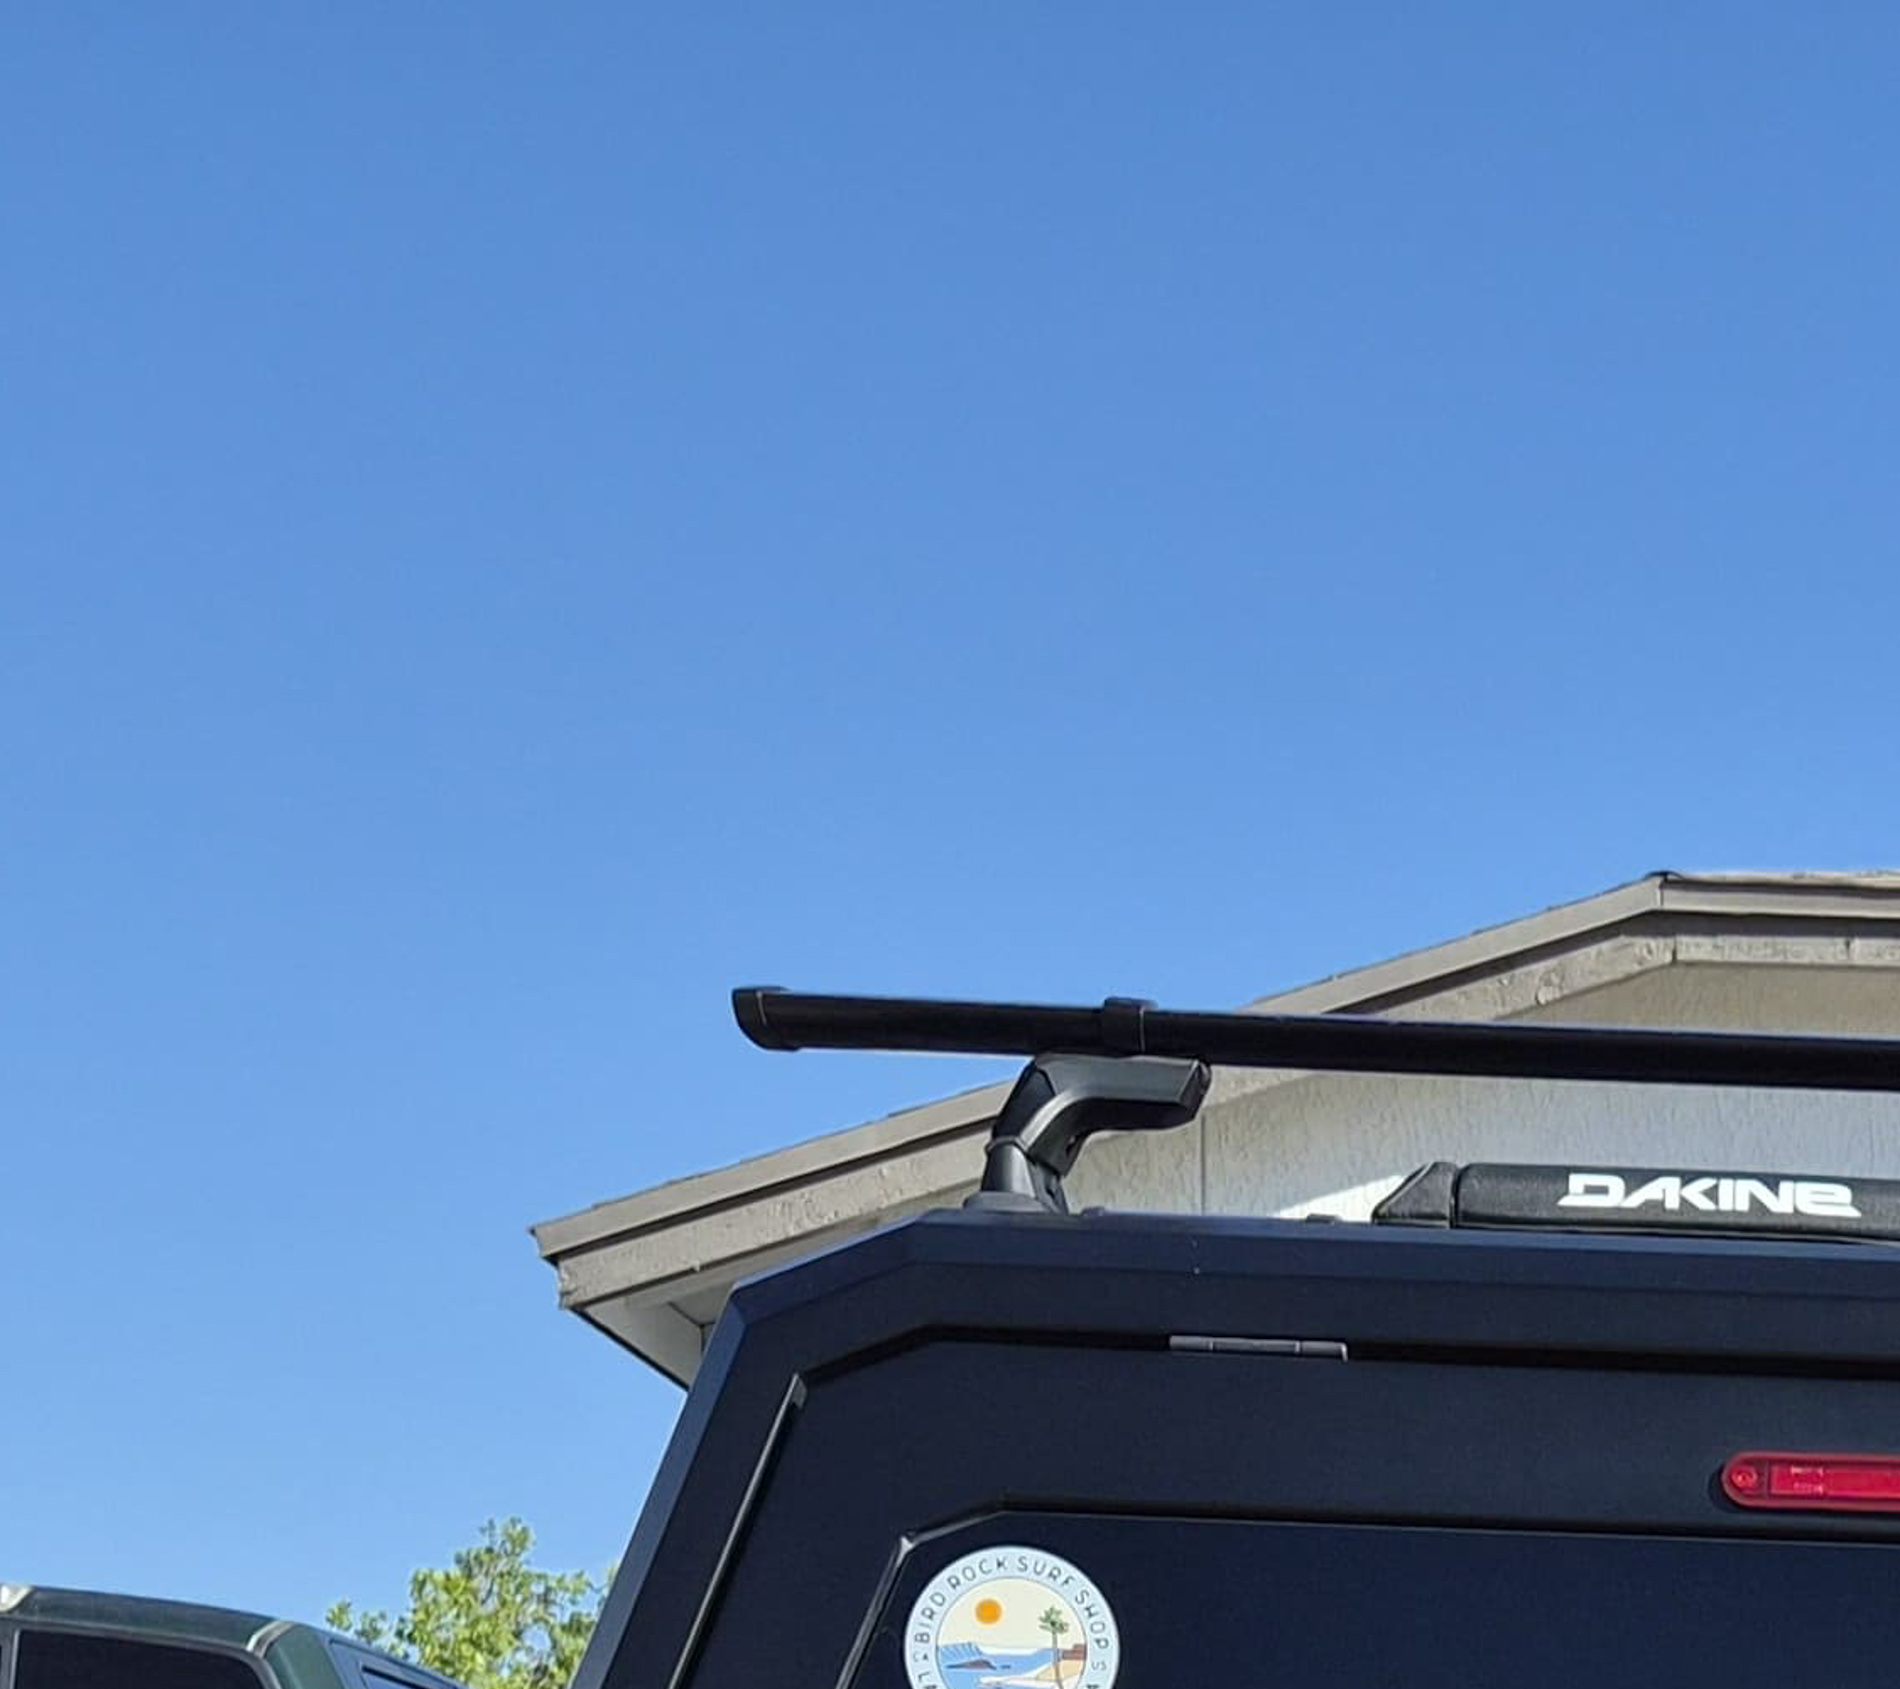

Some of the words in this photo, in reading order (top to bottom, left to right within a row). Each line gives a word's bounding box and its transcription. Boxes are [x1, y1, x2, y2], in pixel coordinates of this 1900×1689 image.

[1557, 1172, 1862, 1218] DAKINE
[914, 1591, 947, 1644] BIRD
[946, 1556, 1009, 1591] ROCK
[1017, 1555, 1076, 1587] SURF
[1075, 1589, 1110, 1650] SHOP
